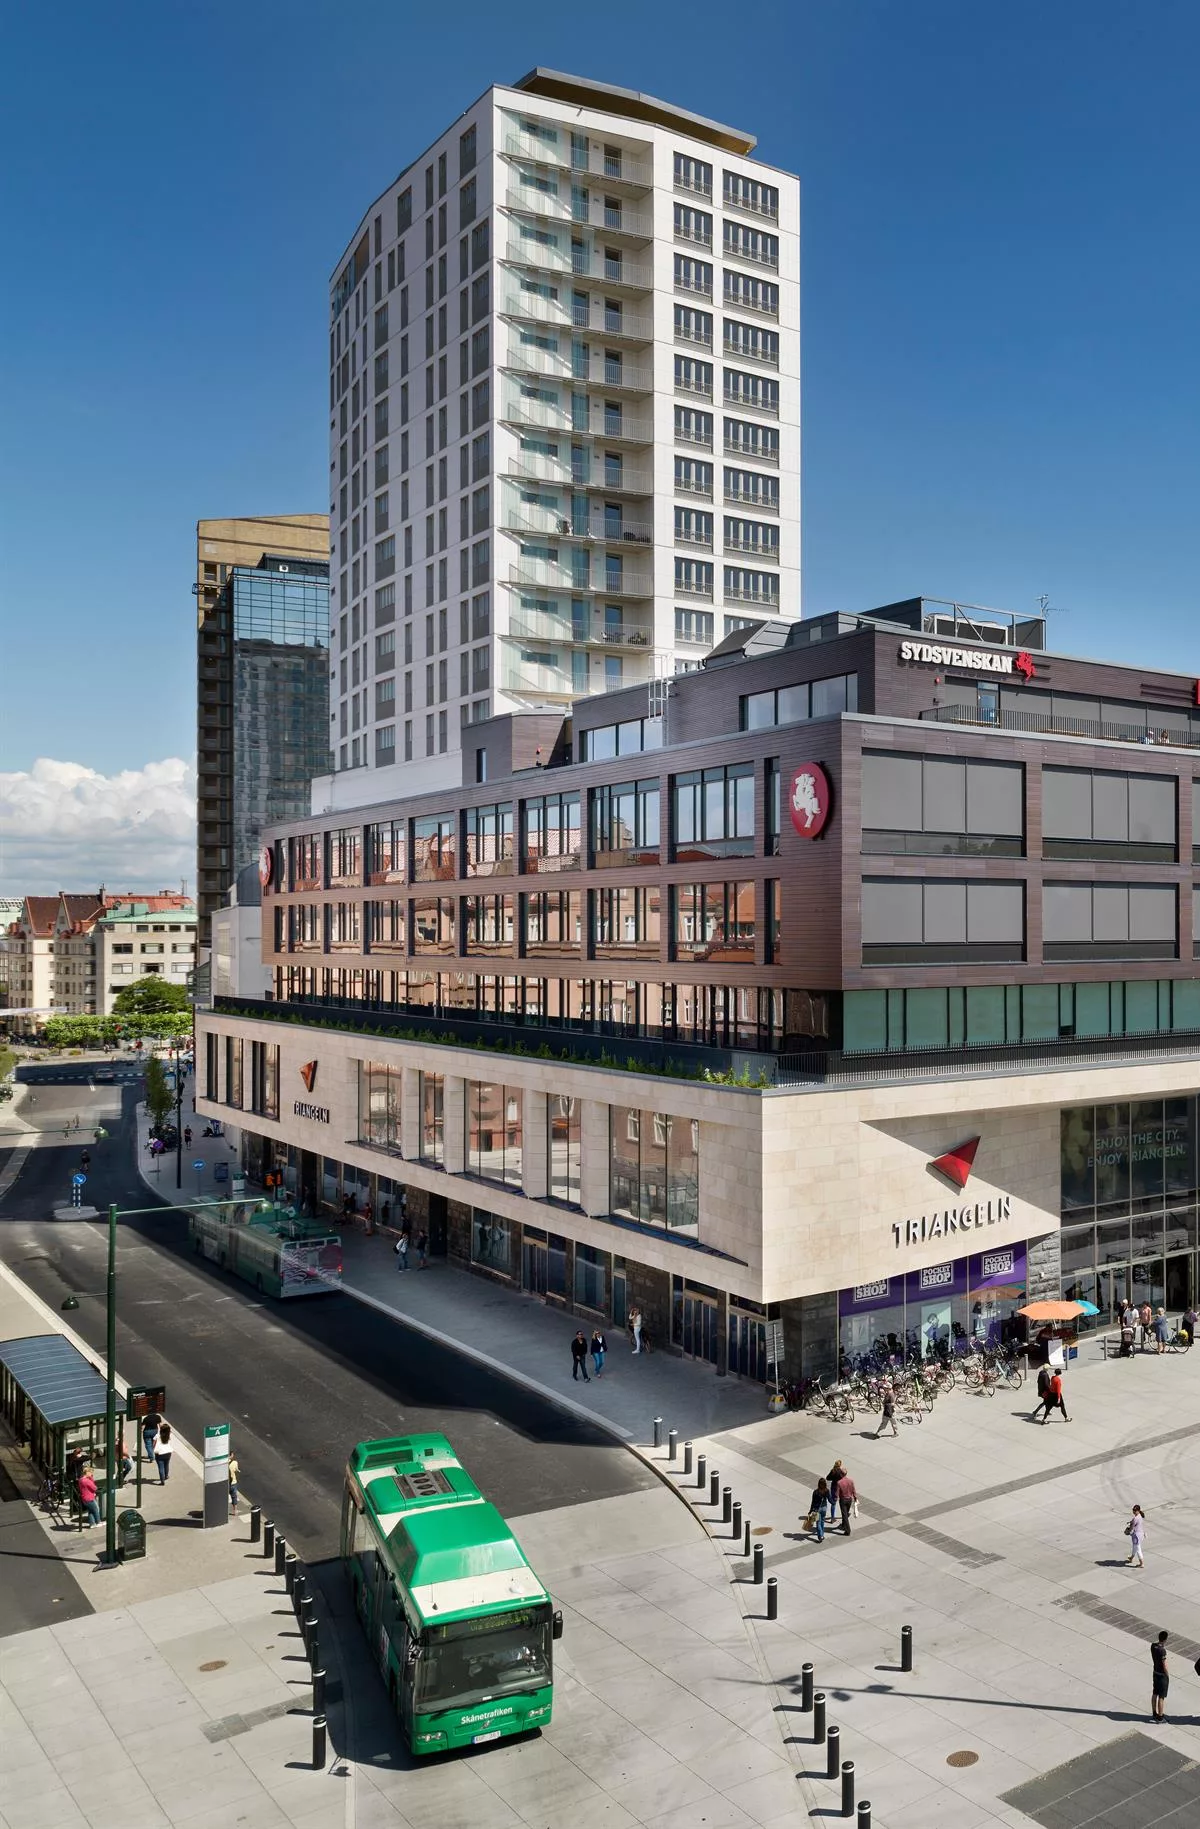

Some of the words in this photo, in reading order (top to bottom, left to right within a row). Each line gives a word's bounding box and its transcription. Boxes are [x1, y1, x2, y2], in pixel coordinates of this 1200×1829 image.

[901, 641, 1013, 673] SYDSVENSKAN
[1095, 1135, 1129, 1150] ENJOY
[1133, 1132, 1153, 1145] THE
[1155, 1128, 1180, 1142] CTY.
[1087, 1151, 1122, 1168] ENJOY
[892, 1196, 1012, 1247] TRIANGELN
[984, 1254, 1011, 1265] POCKET
[984, 1260, 1011, 1274] SHOP
[923, 1265, 951, 1276] POCKET
[922, 1272, 951, 1287] SHOP
[856, 1283, 887, 1299] SHOP
[460, 1706, 513, 1725] Skånetrafiken
